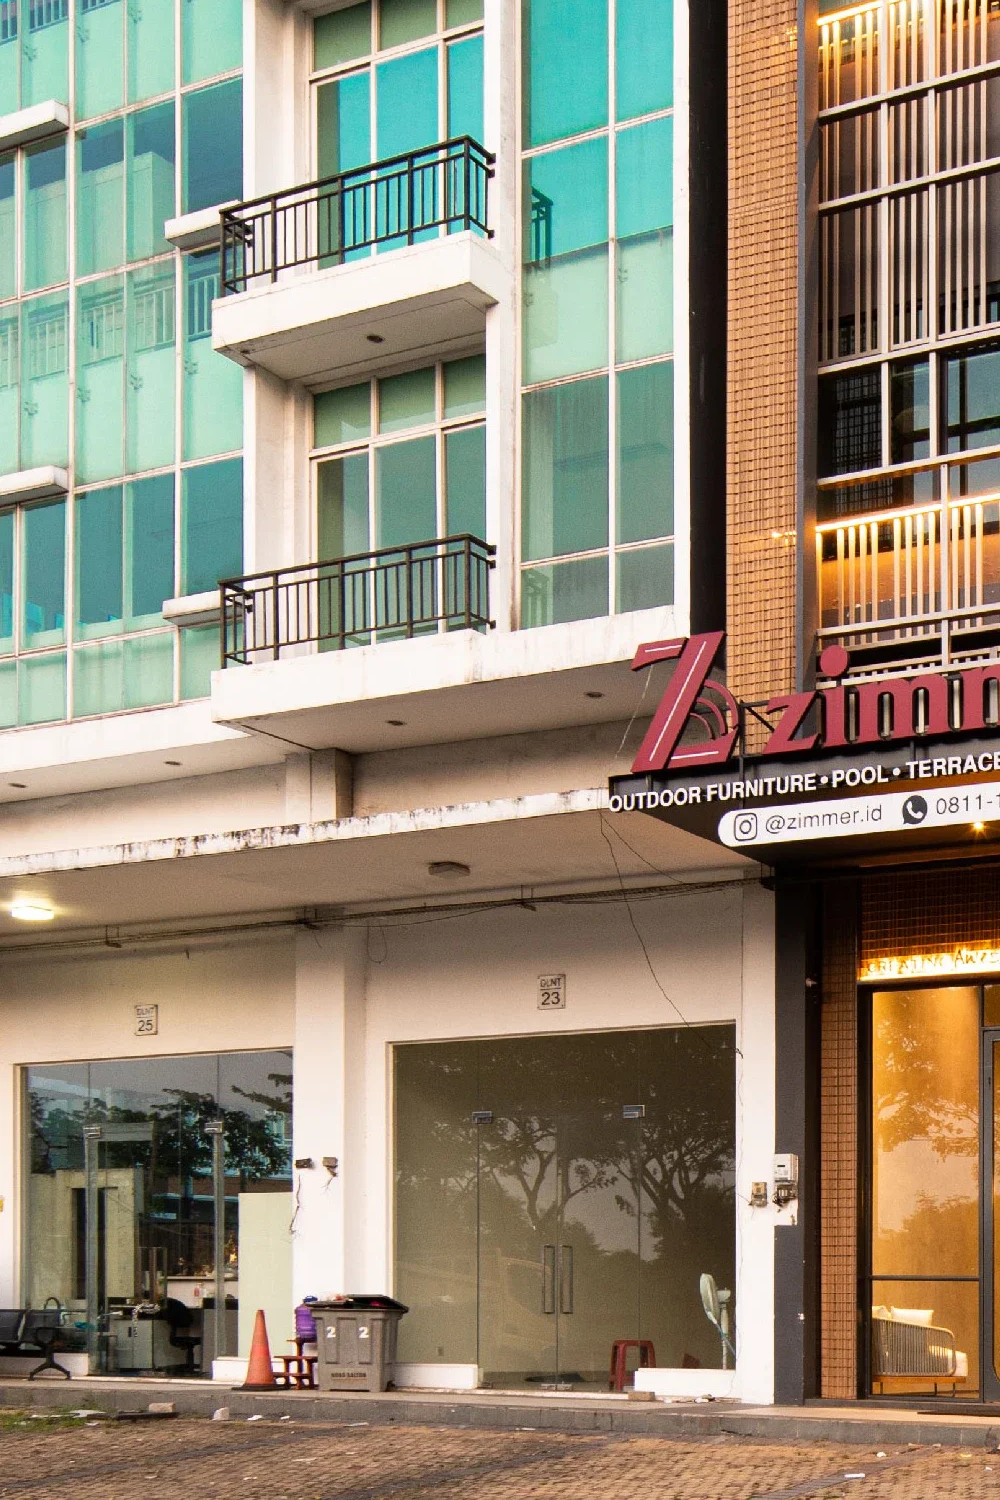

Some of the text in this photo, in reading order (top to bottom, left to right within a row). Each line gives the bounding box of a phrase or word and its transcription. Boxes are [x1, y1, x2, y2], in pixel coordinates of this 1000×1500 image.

[609, 785, 701, 813] OUTDOOR
[706, 772, 817, 802] FURNITURE
[832, 764, 889, 787] POOL
[765, 804, 883, 835] @zimmer.id
[541, 991, 561, 1006] 23
[137, 1019, 154, 1032] 25
[326, 1326, 370, 1338] 2 2
